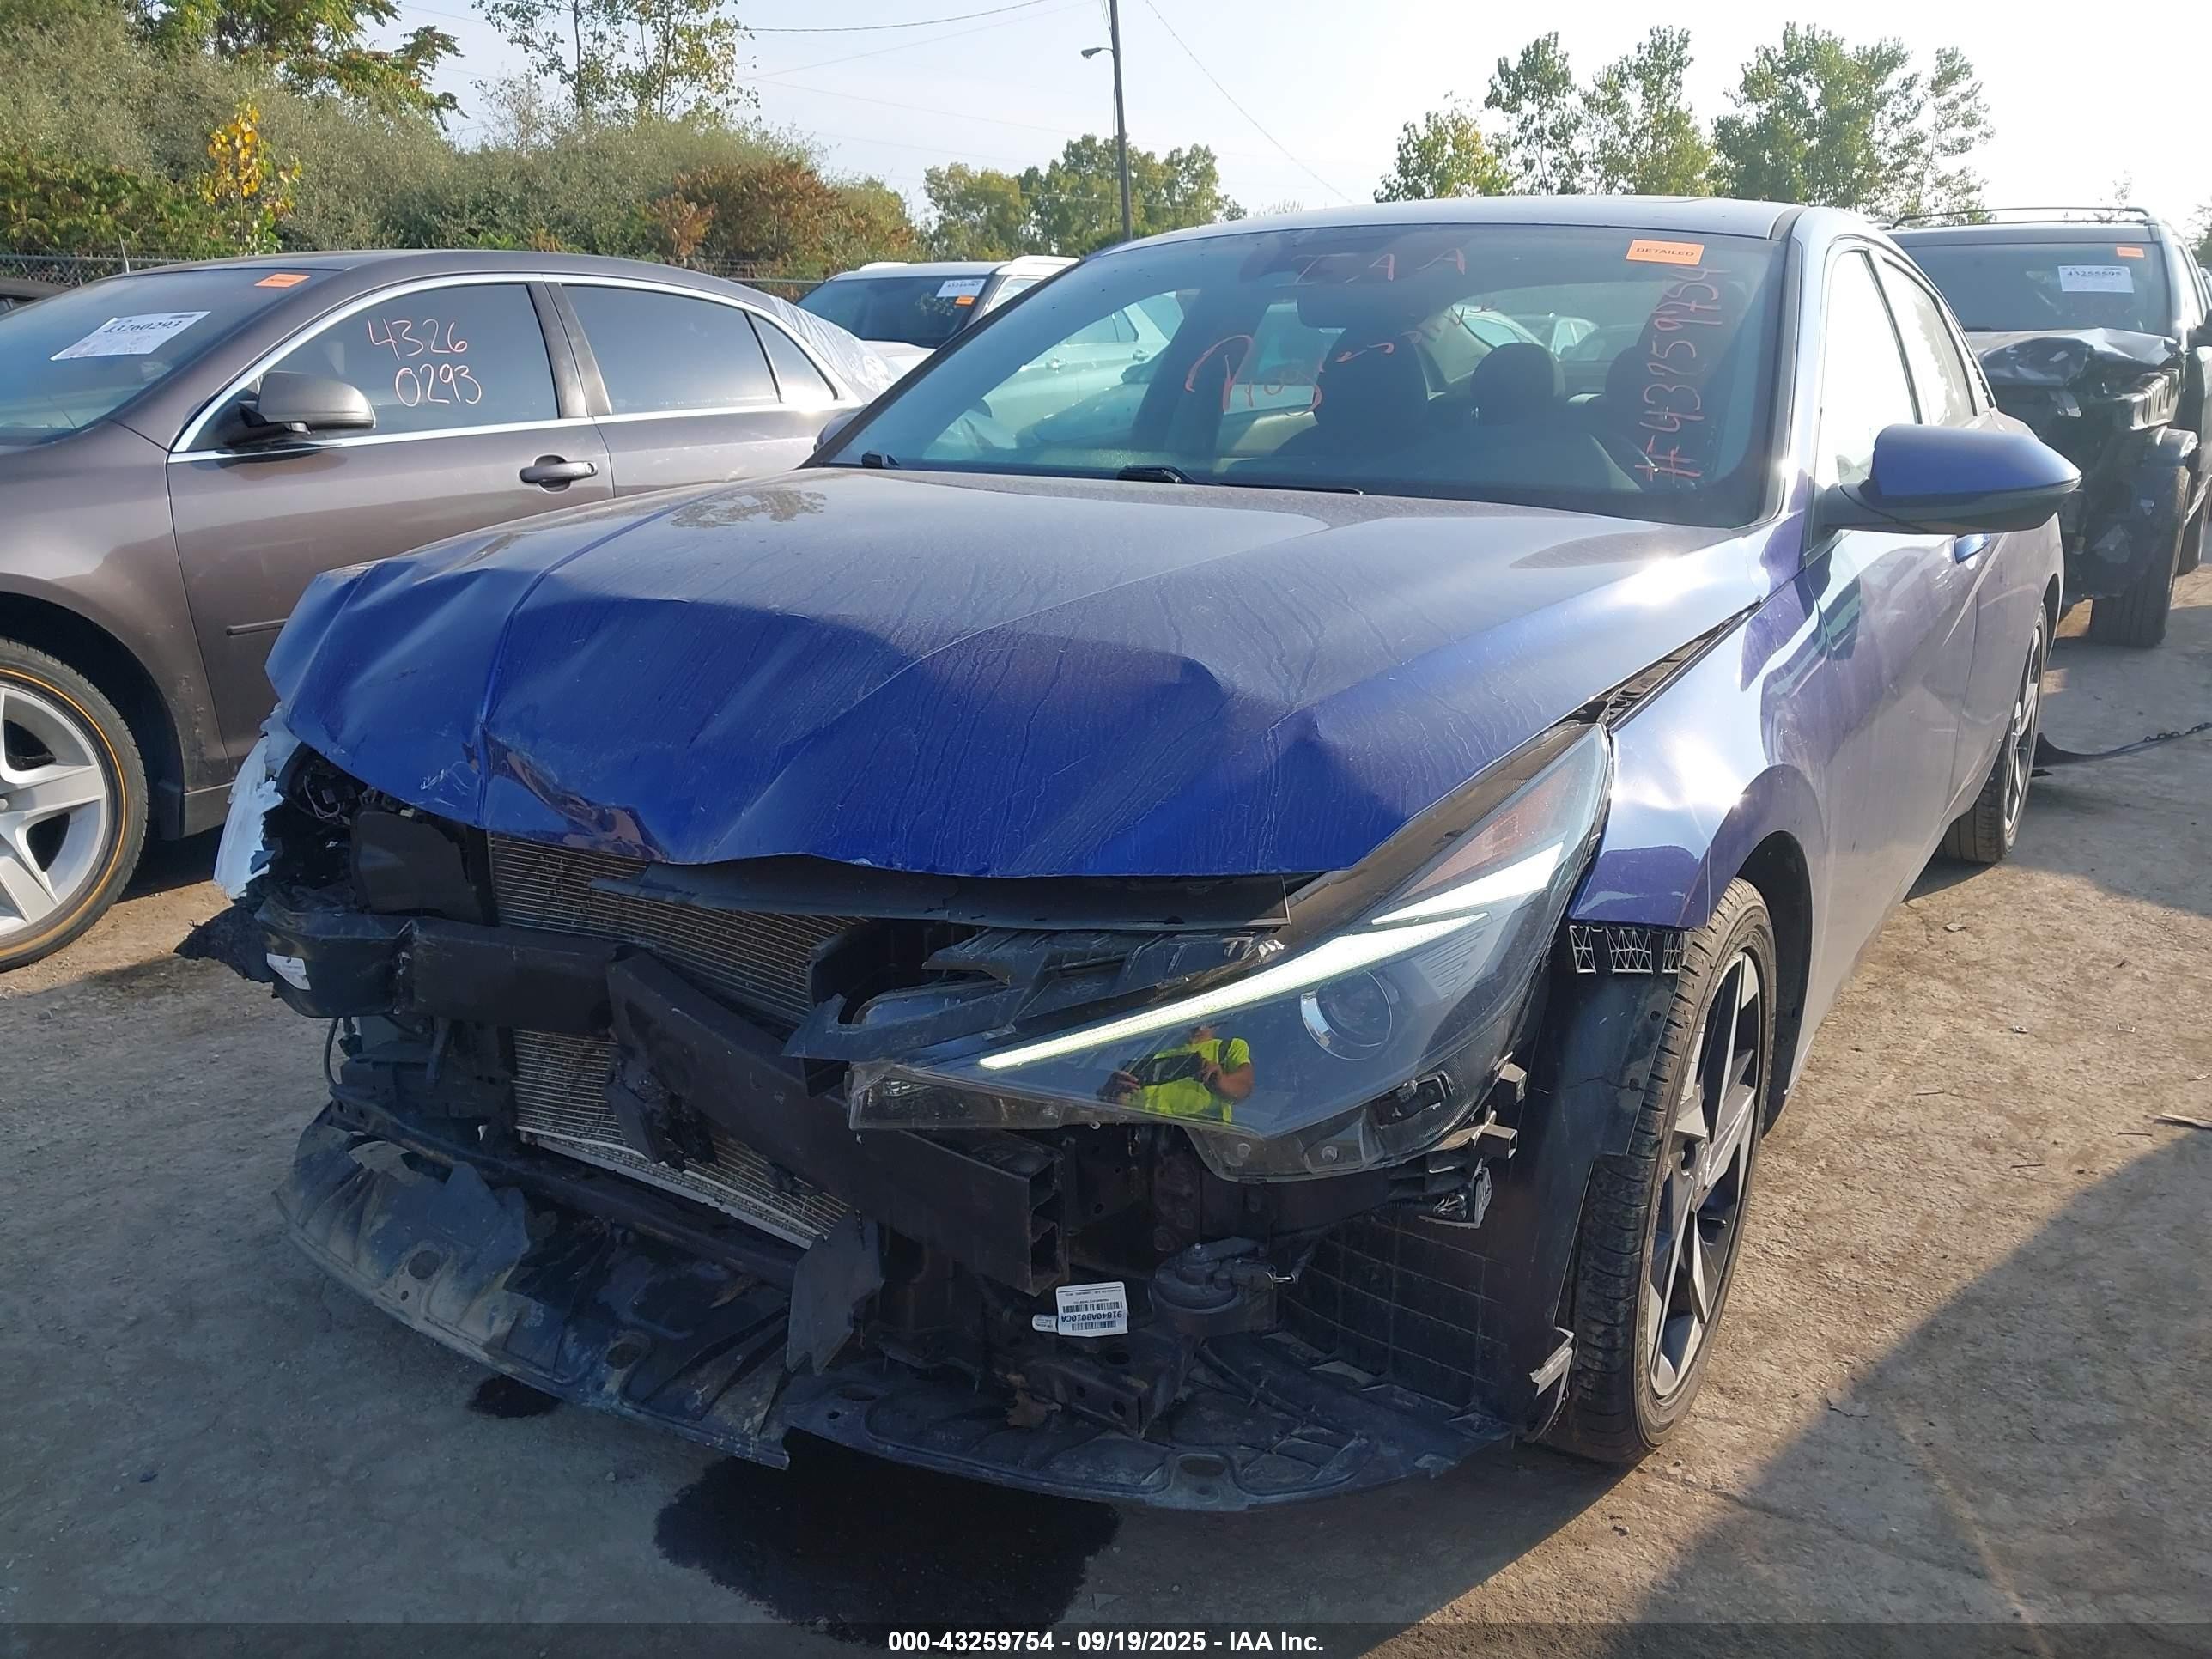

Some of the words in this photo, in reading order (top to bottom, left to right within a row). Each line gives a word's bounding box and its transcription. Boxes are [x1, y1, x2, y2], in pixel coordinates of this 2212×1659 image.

[1636, 246, 1695, 258] DETAILED
[368, 318, 468, 360] 4326
[395, 363, 482, 407] 0293
